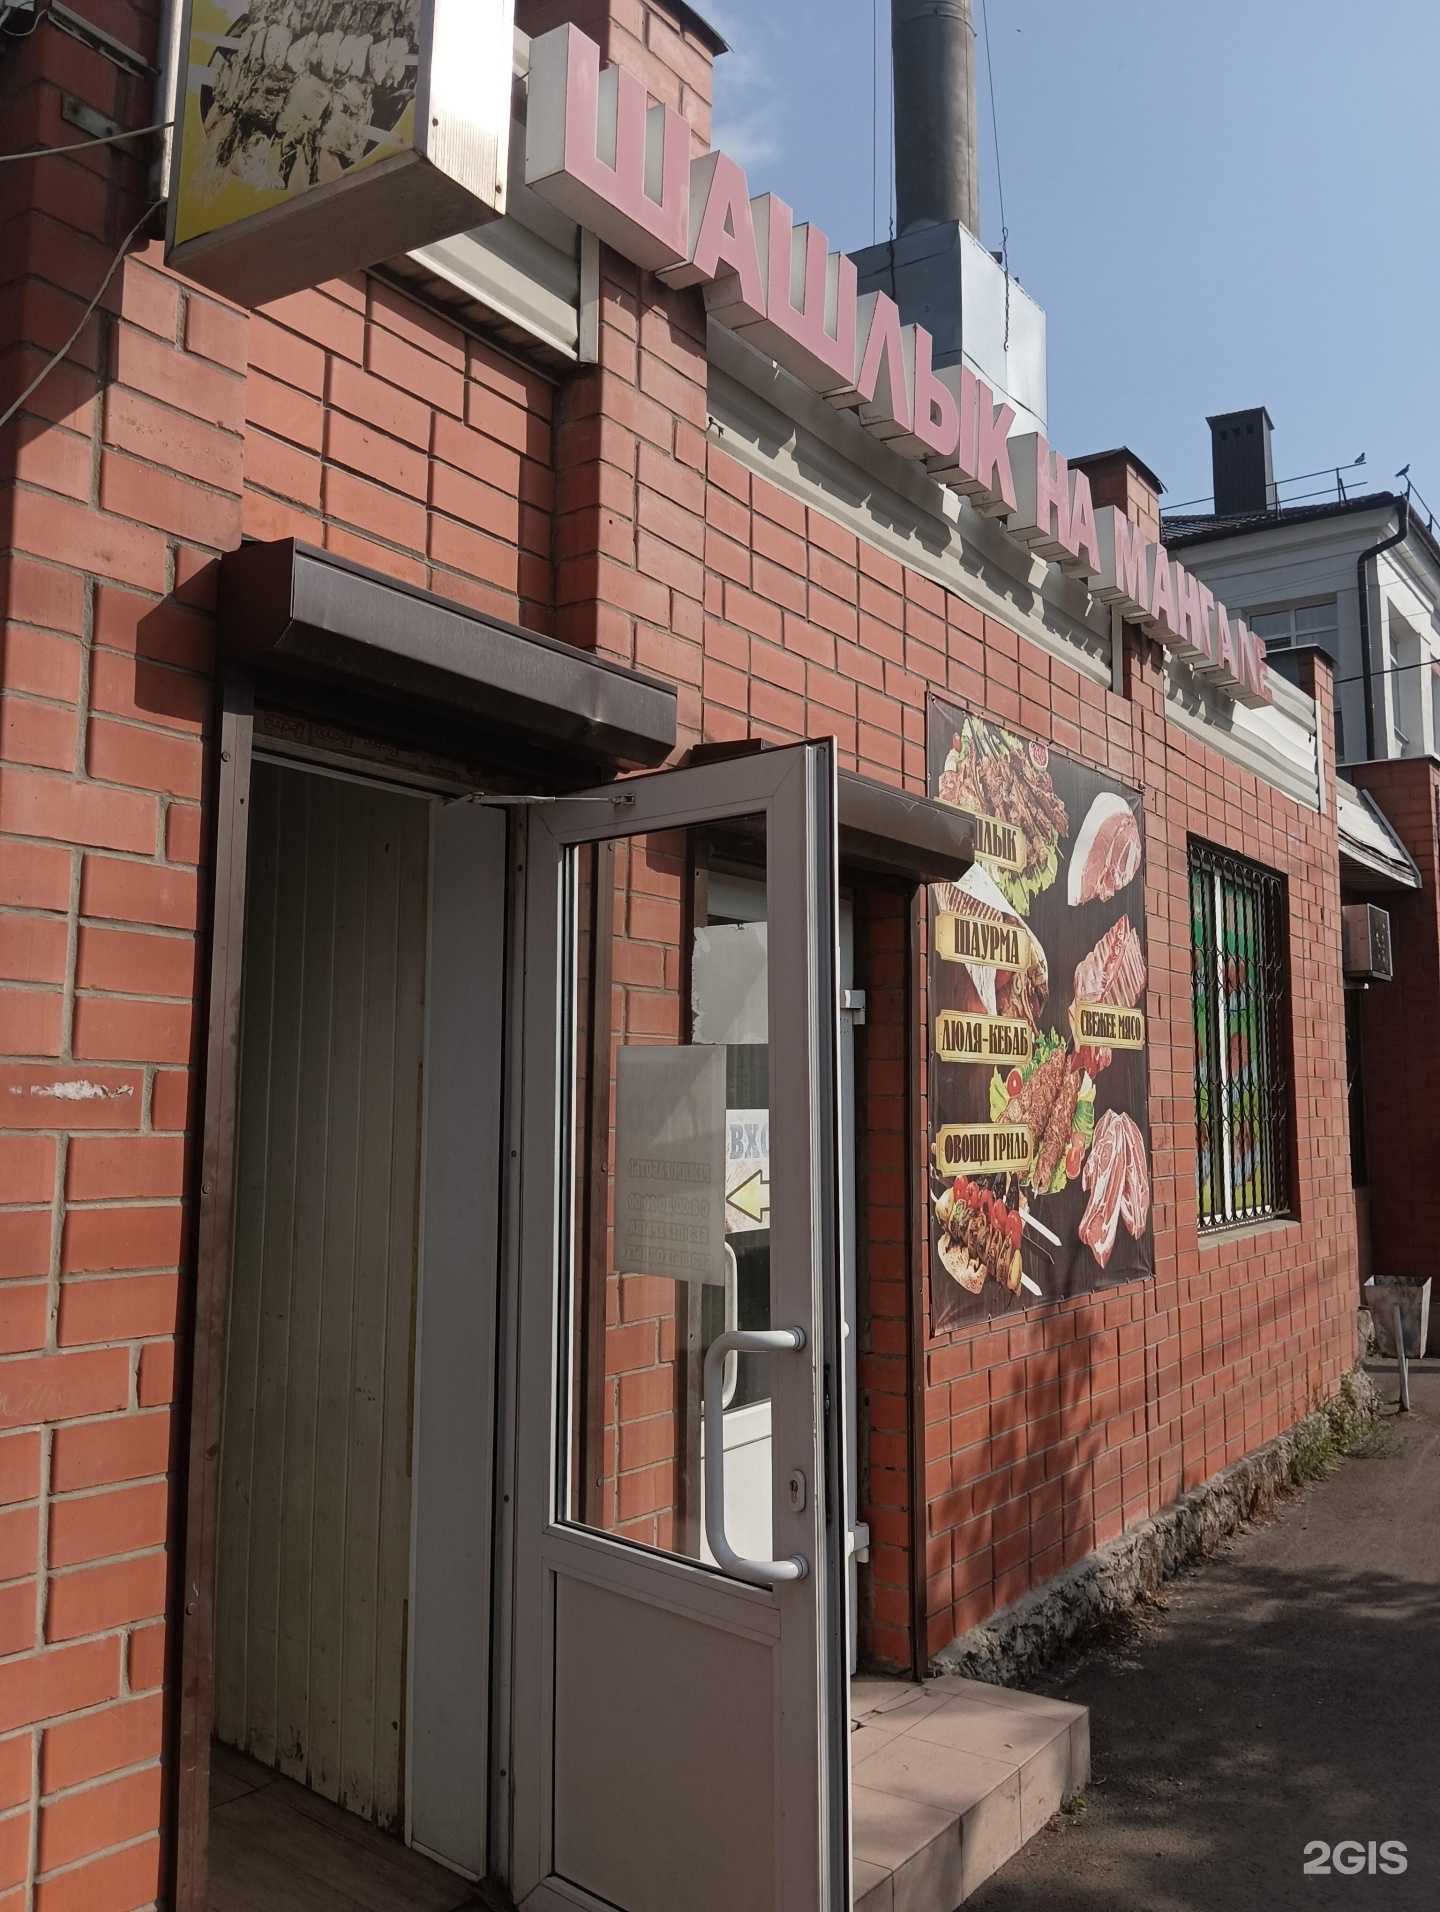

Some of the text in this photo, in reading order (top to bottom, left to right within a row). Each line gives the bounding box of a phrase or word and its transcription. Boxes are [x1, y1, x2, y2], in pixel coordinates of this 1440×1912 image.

[558, 22, 1273, 702] ШАШЛЫК НА МАНГАЛЕ
[954, 917, 1020, 965] ШАУРМА
[942, 1019, 1029, 1056] ЛЮЛЯ-КЕБАБ
[1081, 1009, 1141, 1041] СВЕЖЕЕ МЯСО
[945, 1132, 1029, 1166] ОВОЩИ ГРИЛЬ
